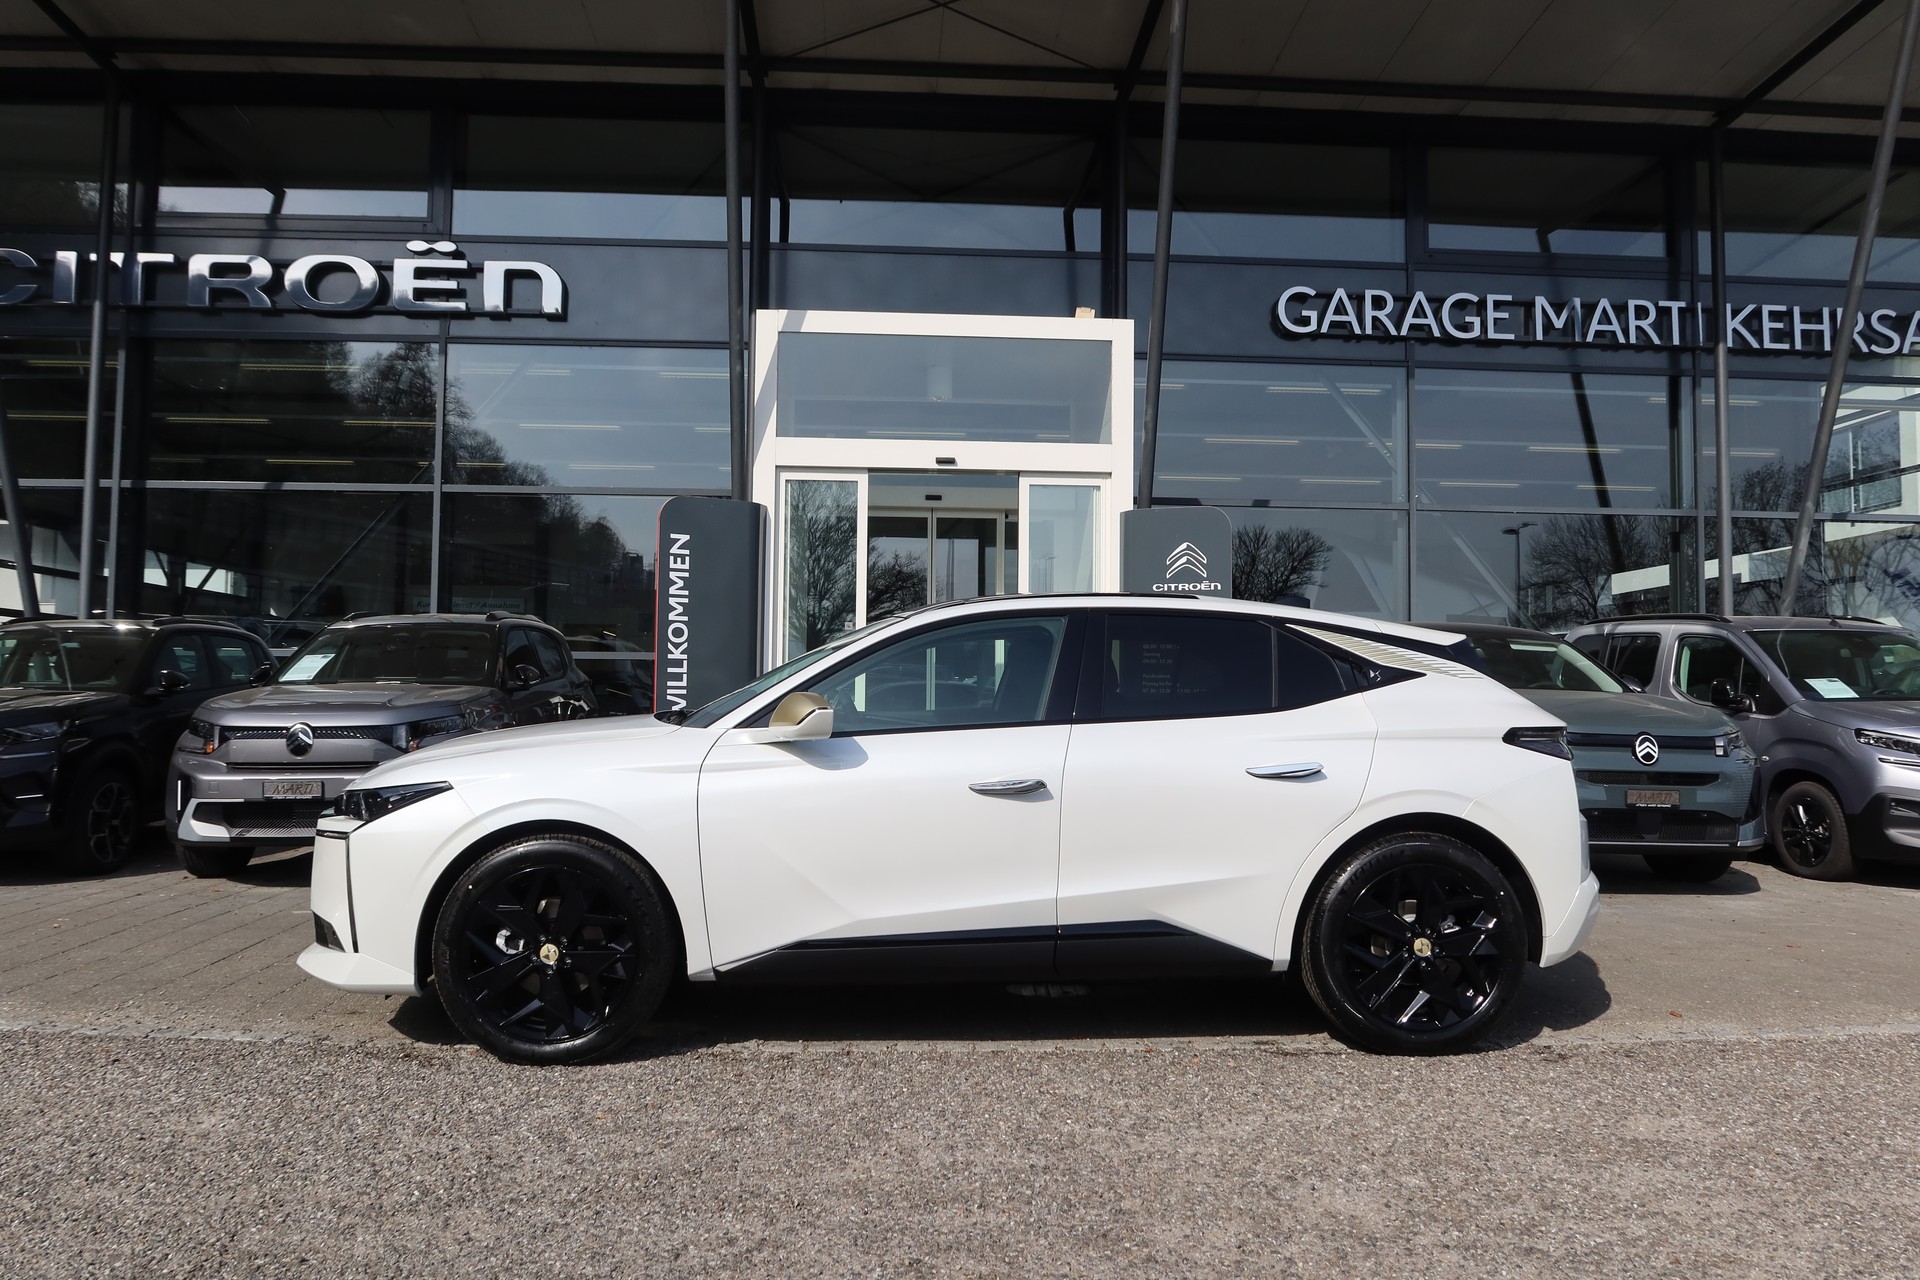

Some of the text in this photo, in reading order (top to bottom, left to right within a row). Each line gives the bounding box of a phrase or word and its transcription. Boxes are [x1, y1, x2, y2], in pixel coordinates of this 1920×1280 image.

[1277, 285, 1515, 341] GARAGE
[1534, 295, 1704, 346] MARTI
[1152, 580, 1221, 592] CITROËN
[271, 783, 314, 795] MARTI
